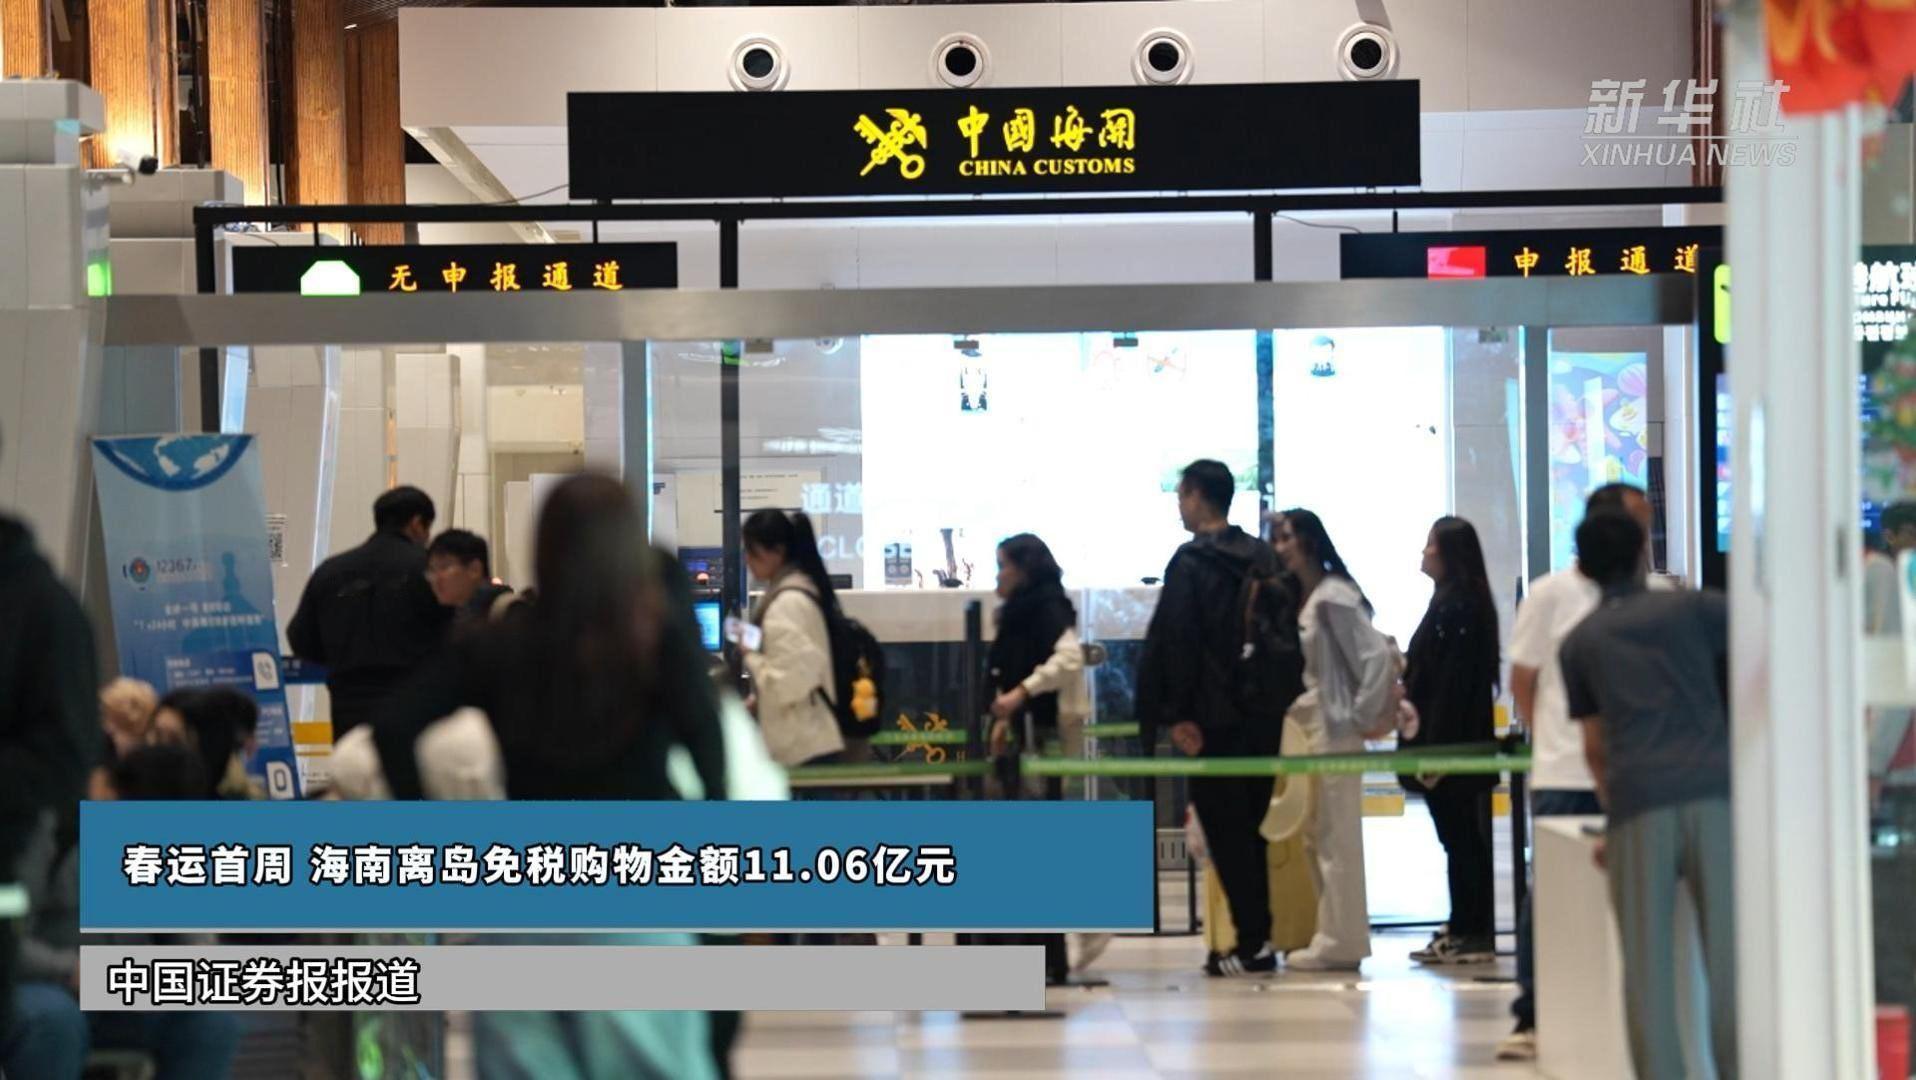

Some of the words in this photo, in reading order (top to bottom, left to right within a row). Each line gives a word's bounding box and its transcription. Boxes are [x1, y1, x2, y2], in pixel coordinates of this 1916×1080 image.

[958, 158, 1027, 177] CHINA
[1033, 157, 1136, 175] CUSTOMS
[388, 260, 624, 292] 无申报通道
[1514, 243, 1699, 278] 申报通道
